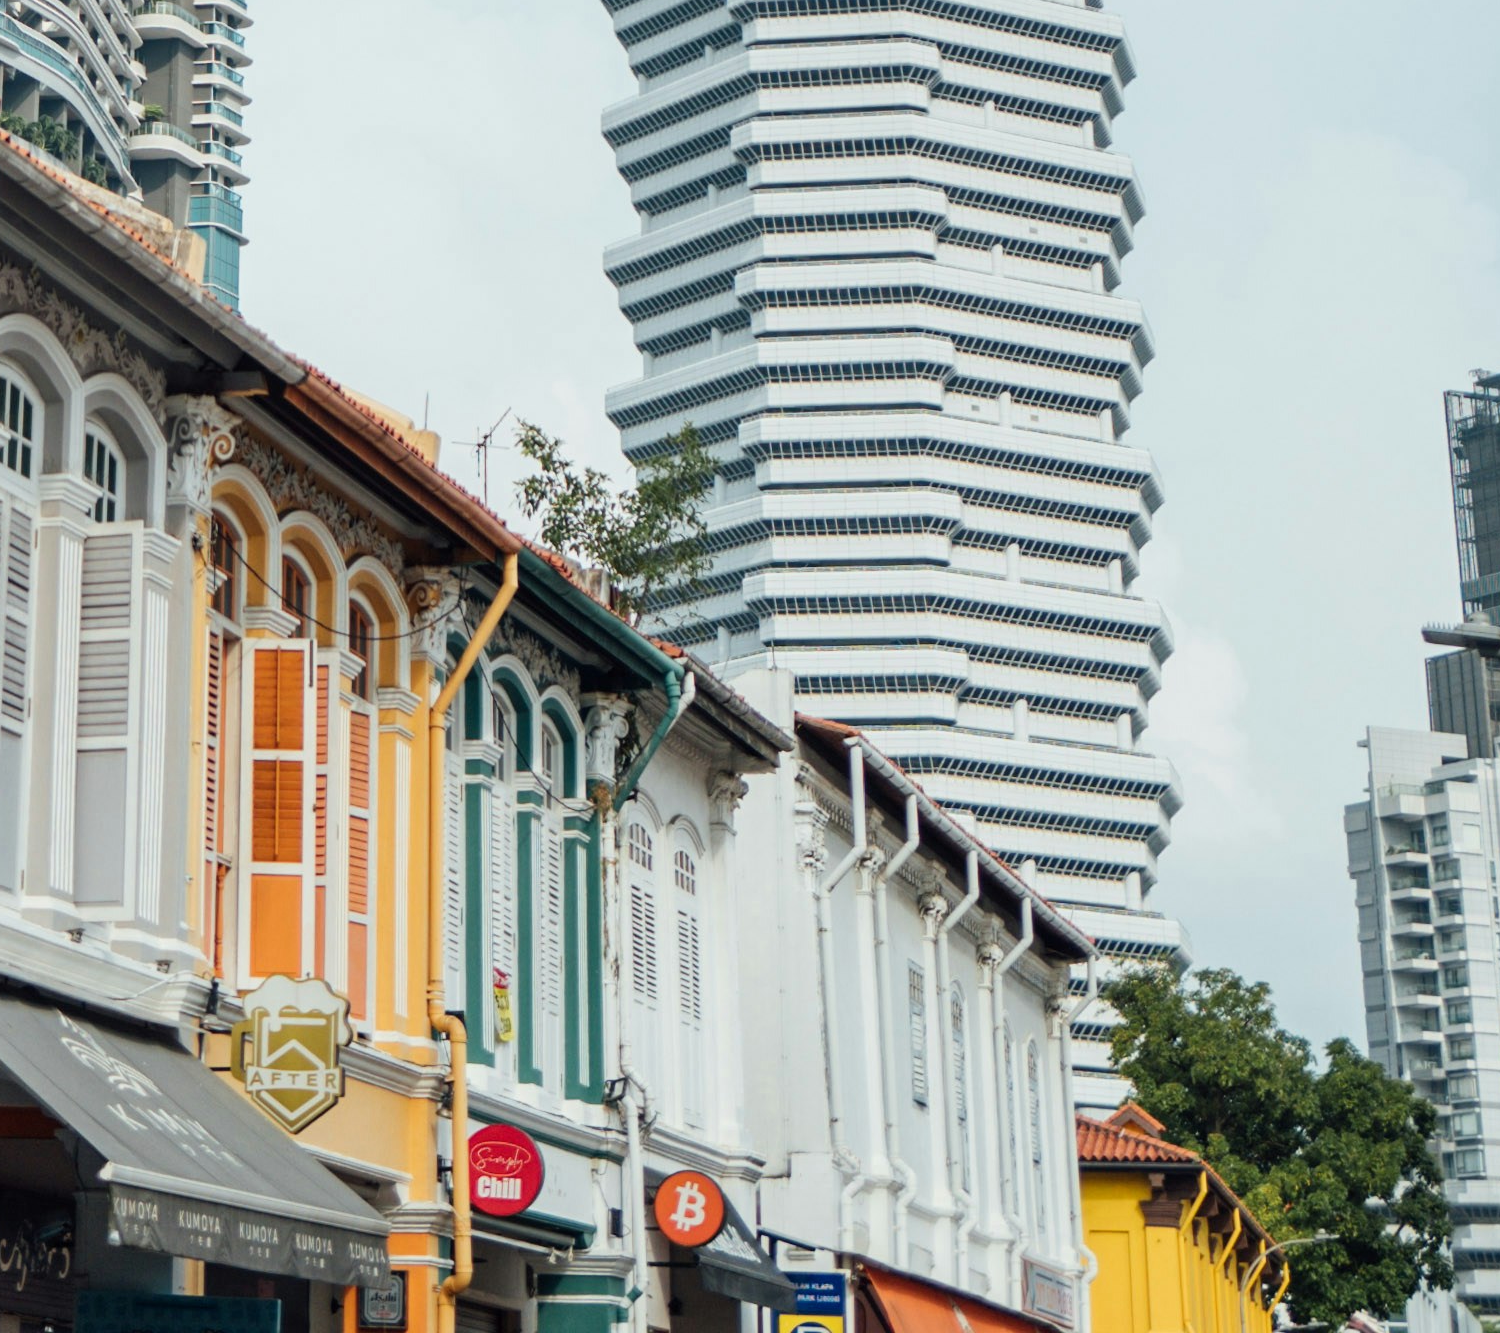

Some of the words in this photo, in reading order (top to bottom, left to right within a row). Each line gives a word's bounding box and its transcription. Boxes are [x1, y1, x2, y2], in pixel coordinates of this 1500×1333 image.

[250, 1072, 337, 1089] AFTER
[477, 1175, 522, 1200] Chill
[179, 1210, 221, 1234] KUMOYA
[239, 1221, 279, 1245] KUMOYA
[296, 1232, 333, 1255] KUMOYA
